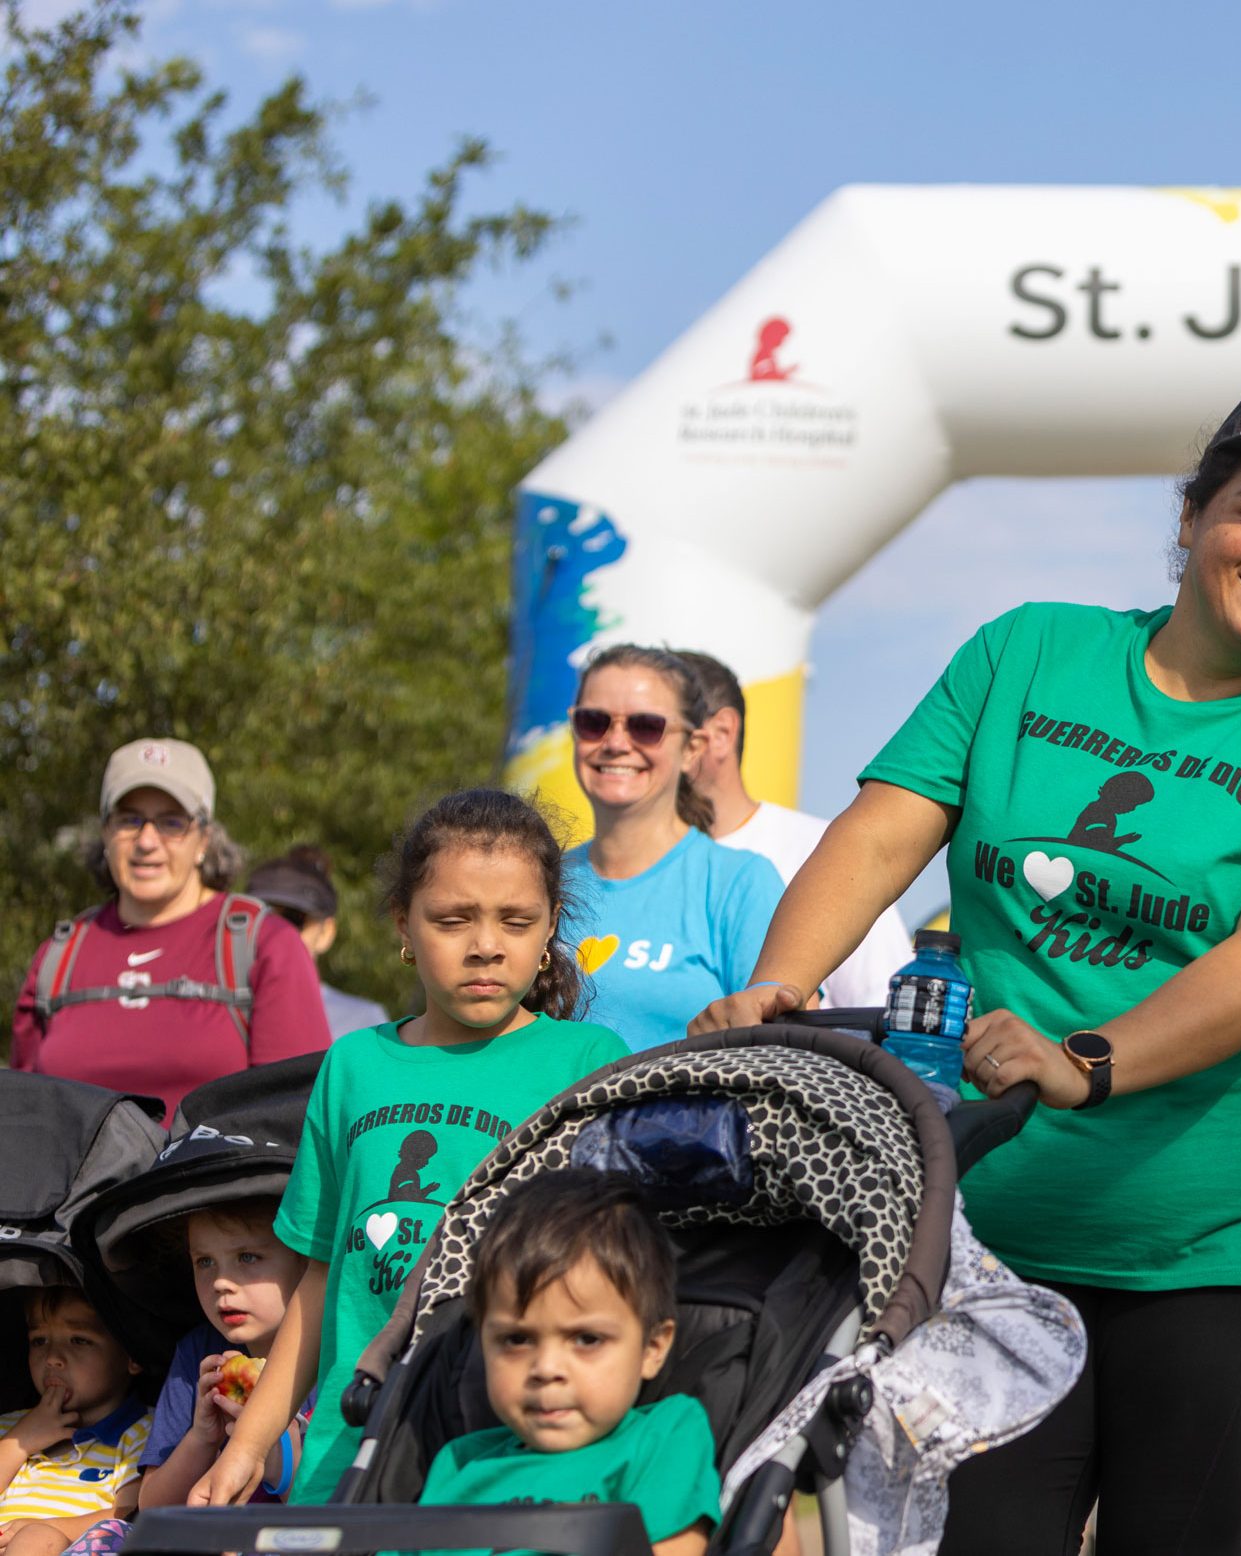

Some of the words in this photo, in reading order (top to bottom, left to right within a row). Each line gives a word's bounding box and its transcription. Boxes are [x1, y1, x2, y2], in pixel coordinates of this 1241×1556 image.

[1009, 263, 1151, 340] St.
[1017, 711, 1177, 771] GUERREROS
[1175, 755, 1213, 779] DE
[974, 841, 1015, 889] We
[1075, 871, 1118, 914] St.
[1125, 885, 1210, 933] Jude
[623, 939, 674, 972] SJ
[1014, 904, 1154, 971] Kids
[347, 1102, 445, 1150] UERREROS
[445, 1104, 474, 1128] DE
[474, 1109, 513, 1141] DIO
[397, 1217, 426, 1245] St.
[369, 1250, 412, 1296] Ki
